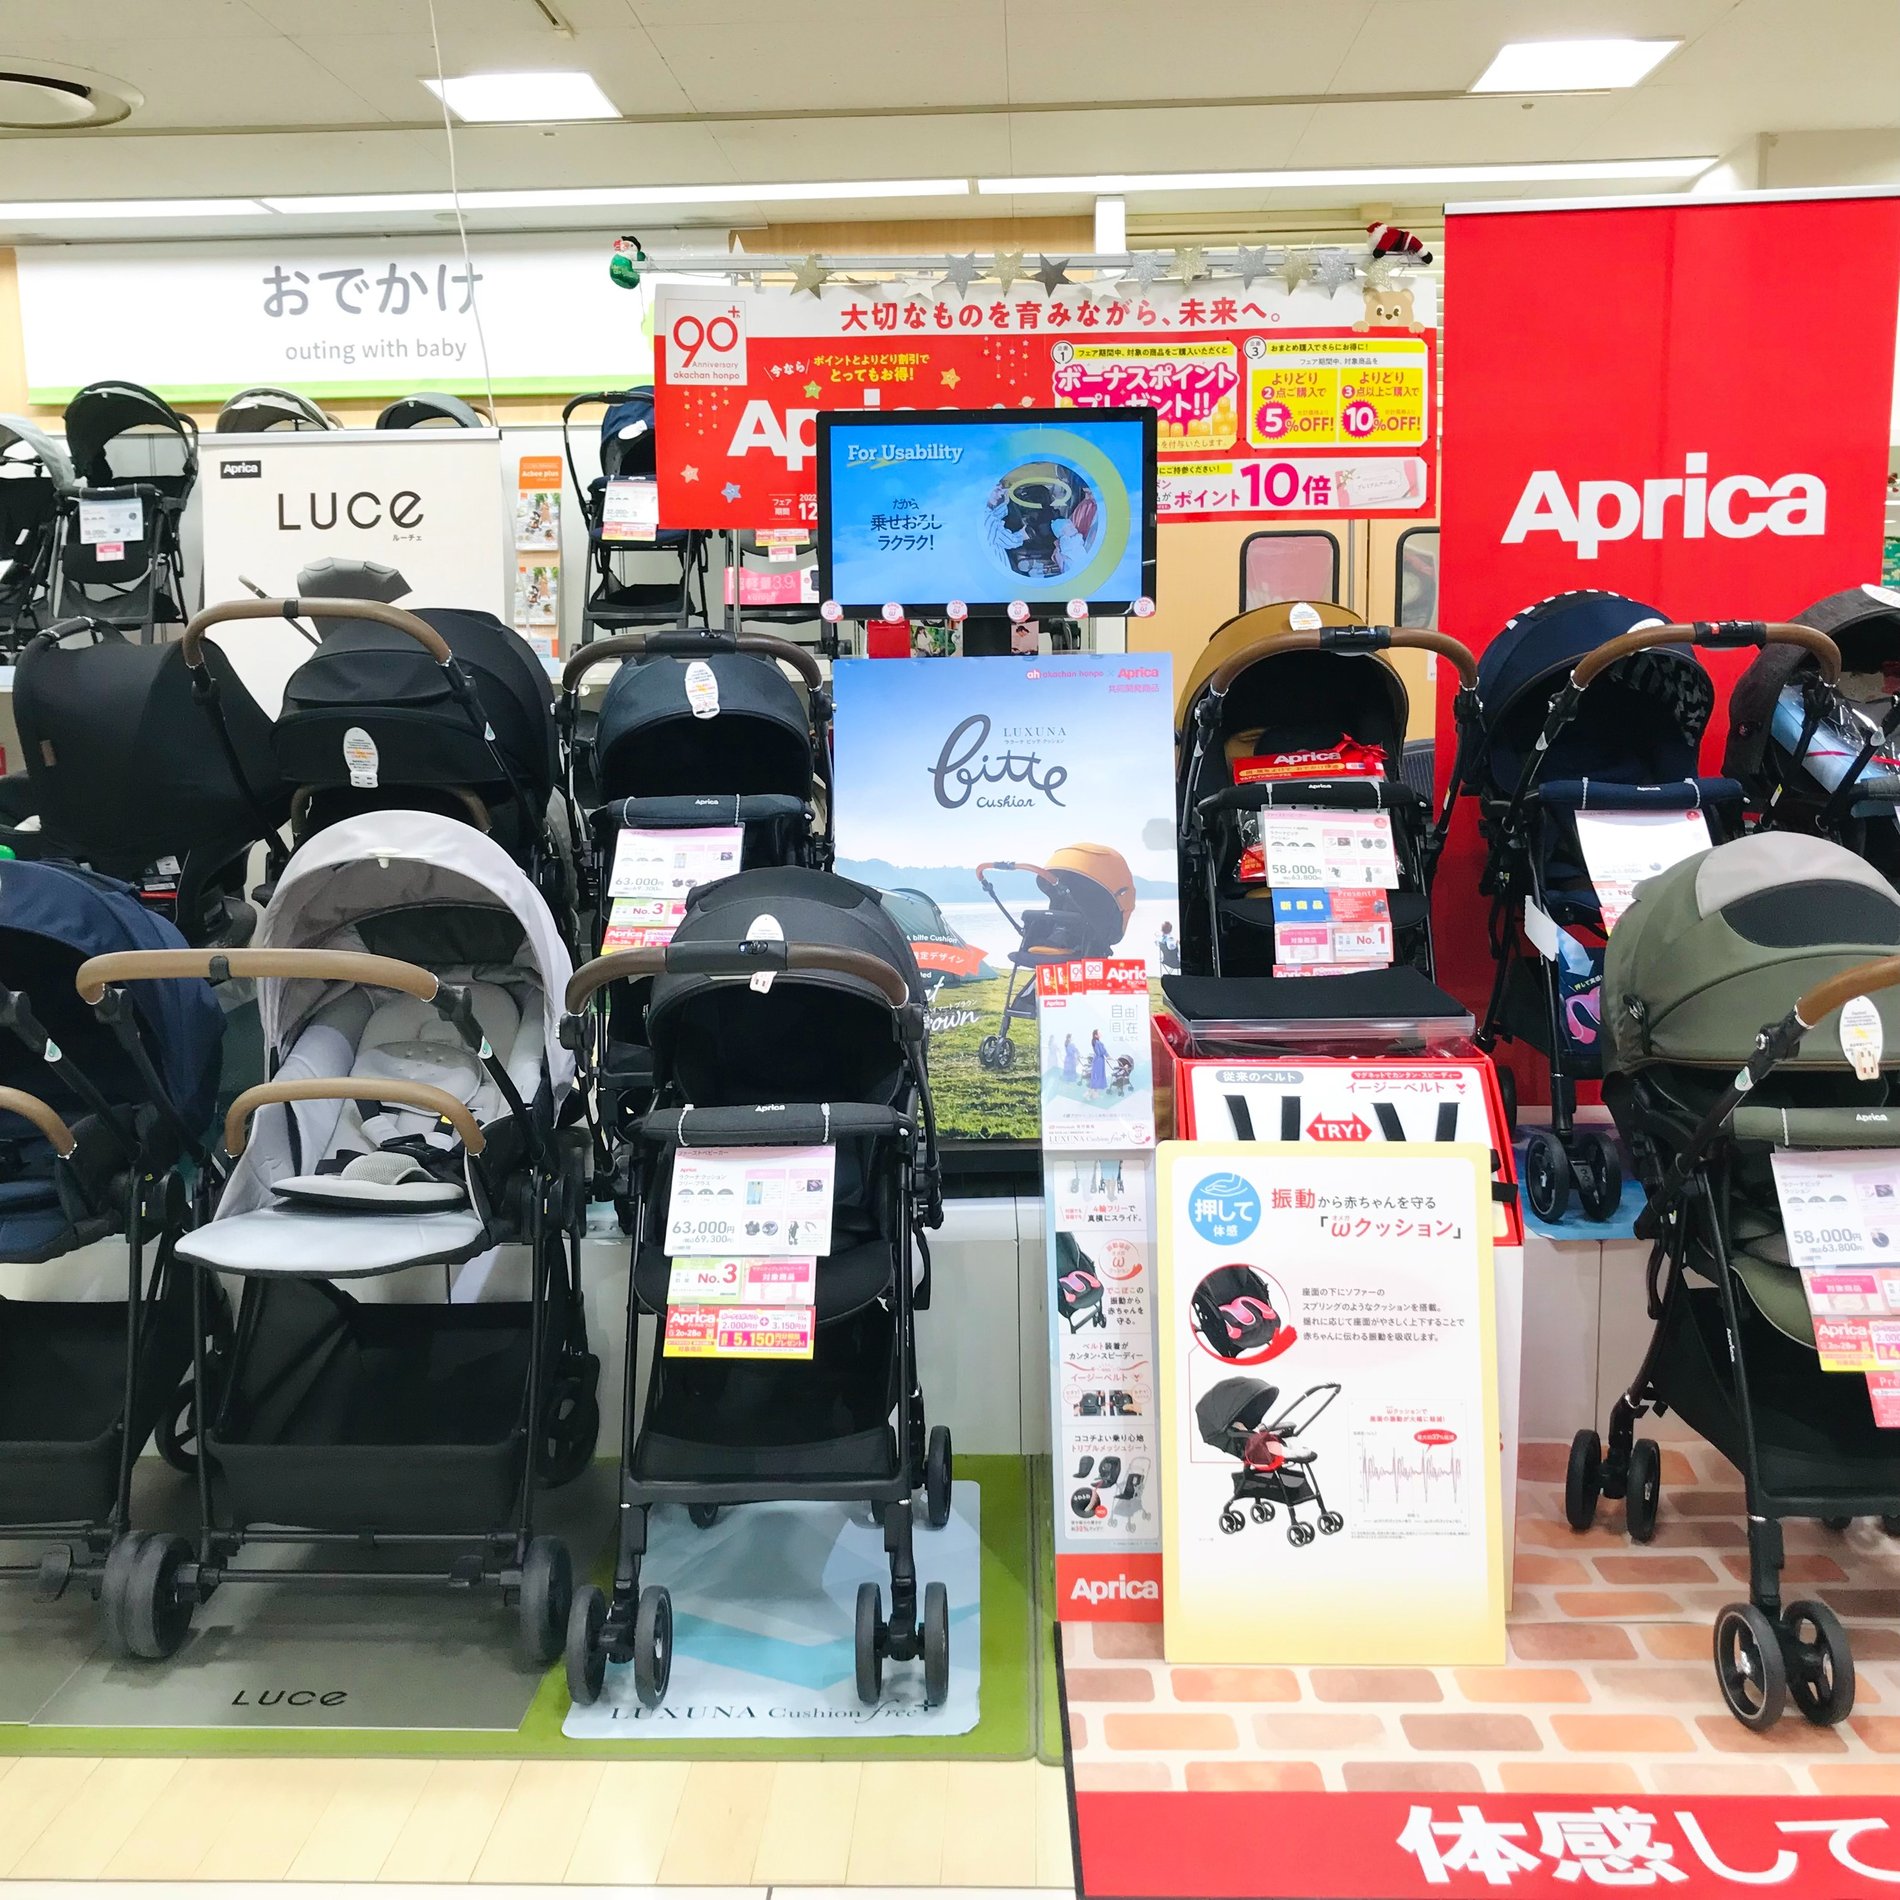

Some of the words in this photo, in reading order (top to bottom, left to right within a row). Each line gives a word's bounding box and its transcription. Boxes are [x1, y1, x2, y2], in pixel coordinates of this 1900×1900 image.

[262, 262, 484, 319] おでかけ
[840, 297, 1281, 332] 大切なものを育みながら、未来へ。
[285, 339, 356, 365] outing
[361, 337, 408, 359] with
[415, 336, 467, 362] baby
[692, 360, 739, 369] Anniversary
[813, 353, 930, 367] ポイントとよりどり割引で
[673, 371, 711, 380] akachan
[712, 371, 740, 381] honpo
[770, 361, 806, 378] 今なら
[829, 367, 914, 383] とってもお得!
[1056, 362, 1236, 392] ボーナスポイント
[1272, 372, 1318, 386] よりどり
[1359, 371, 1405, 385] よりどり
[847, 444, 878, 461] For
[880, 444, 964, 465] Usability
[223, 462, 259, 476] Aprica
[1157, 463, 1221, 475] にご持参ください!
[1240, 462, 1300, 507] 10
[772, 498, 793, 506] フェア
[1173, 488, 1241, 509] ポイント
[799, 502, 818, 521] 12
[1500, 452, 1828, 560] Aprica
[870, 513, 943, 531] 乗せおろし
[392, 534, 423, 542] ルーチェ
[877, 534, 935, 551] ラクラク!
[1118, 667, 1159, 680] Aprica
[1003, 726, 1068, 737] LUXUNA
[1273, 751, 1342, 766] Aprica
[694, 798, 719, 806] Aprica
[975, 795, 1037, 809] Cushion
[1222, 1071, 1296, 1083] 従来のベルト
[1346, 1081, 1445, 1094] イージーベルト
[754, 1103, 785, 1112] Aprica
[1855, 1112, 1889, 1122] Aprica
[1314, 1123, 1364, 1139] TRY!
[1271, 1187, 1437, 1210] 振動から赤ちゃんを守る
[1194, 1199, 1254, 1223] 押して
[672, 1220, 735, 1235] 63,000円
[1212, 1224, 1239, 1237] 体感
[1793, 1228, 1863, 1244] 58,000円
[1301, 1287, 1386, 1297] 座面の下にソファーの
[1301, 1302, 1442, 1312] スプリングのようなクッションを搭載。
[669, 1310, 716, 1325] Aprica
[1302, 1316, 1465, 1327] 揺れに応じて座面がやさしく上下することで
[1302, 1331, 1439, 1342] 赤ちゃんに伝わる振動を吸収します。
[1817, 1324, 1868, 1341] Aprica
[1071, 1373, 1128, 1383] イージーベルト
[1071, 1444, 1149, 1453] トリプルメッシュシート
[1070, 1573, 1159, 1606] Aprica
[610, 1704, 757, 1720] LUXUNA
[767, 1704, 862, 1720] Cushion
[1397, 1805, 1900, 1886] 体感して
